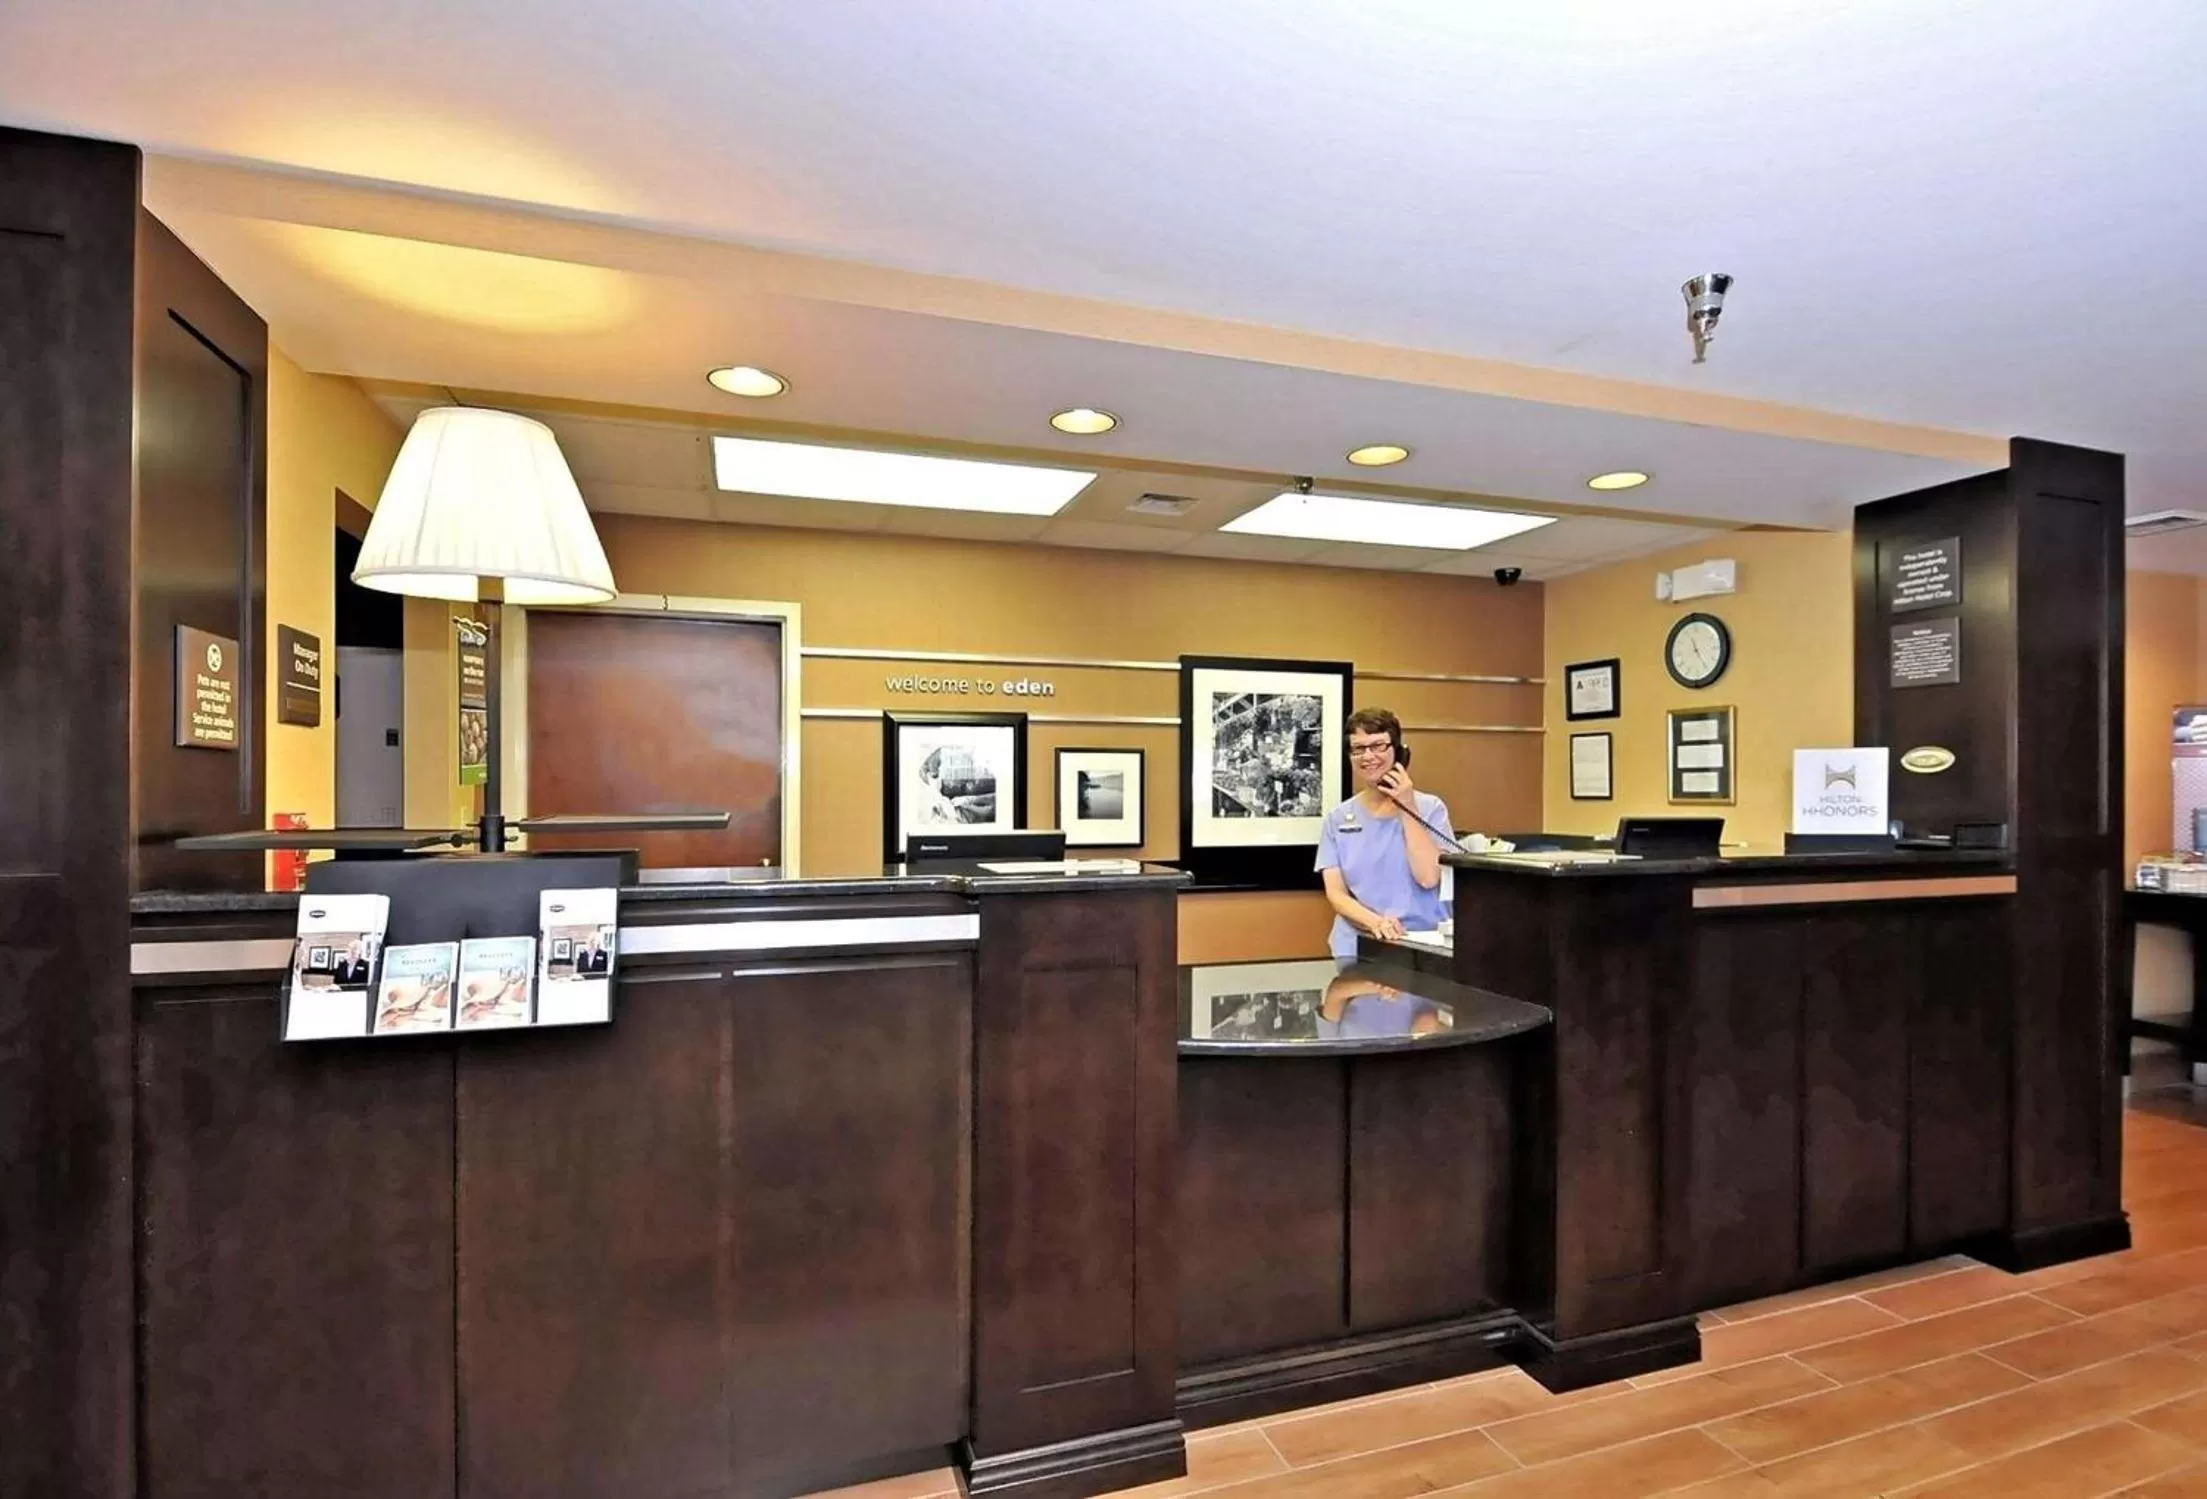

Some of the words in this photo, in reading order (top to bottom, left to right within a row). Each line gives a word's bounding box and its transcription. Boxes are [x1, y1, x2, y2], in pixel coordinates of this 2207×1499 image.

[293, 641, 319, 663] Manager
[885, 674, 969, 694] welcome
[976, 680, 996, 694] to
[1002, 678, 1054, 696] eden
[1819, 794, 1861, 804] HILTON
[1802, 805, 1879, 818] HHONORS
